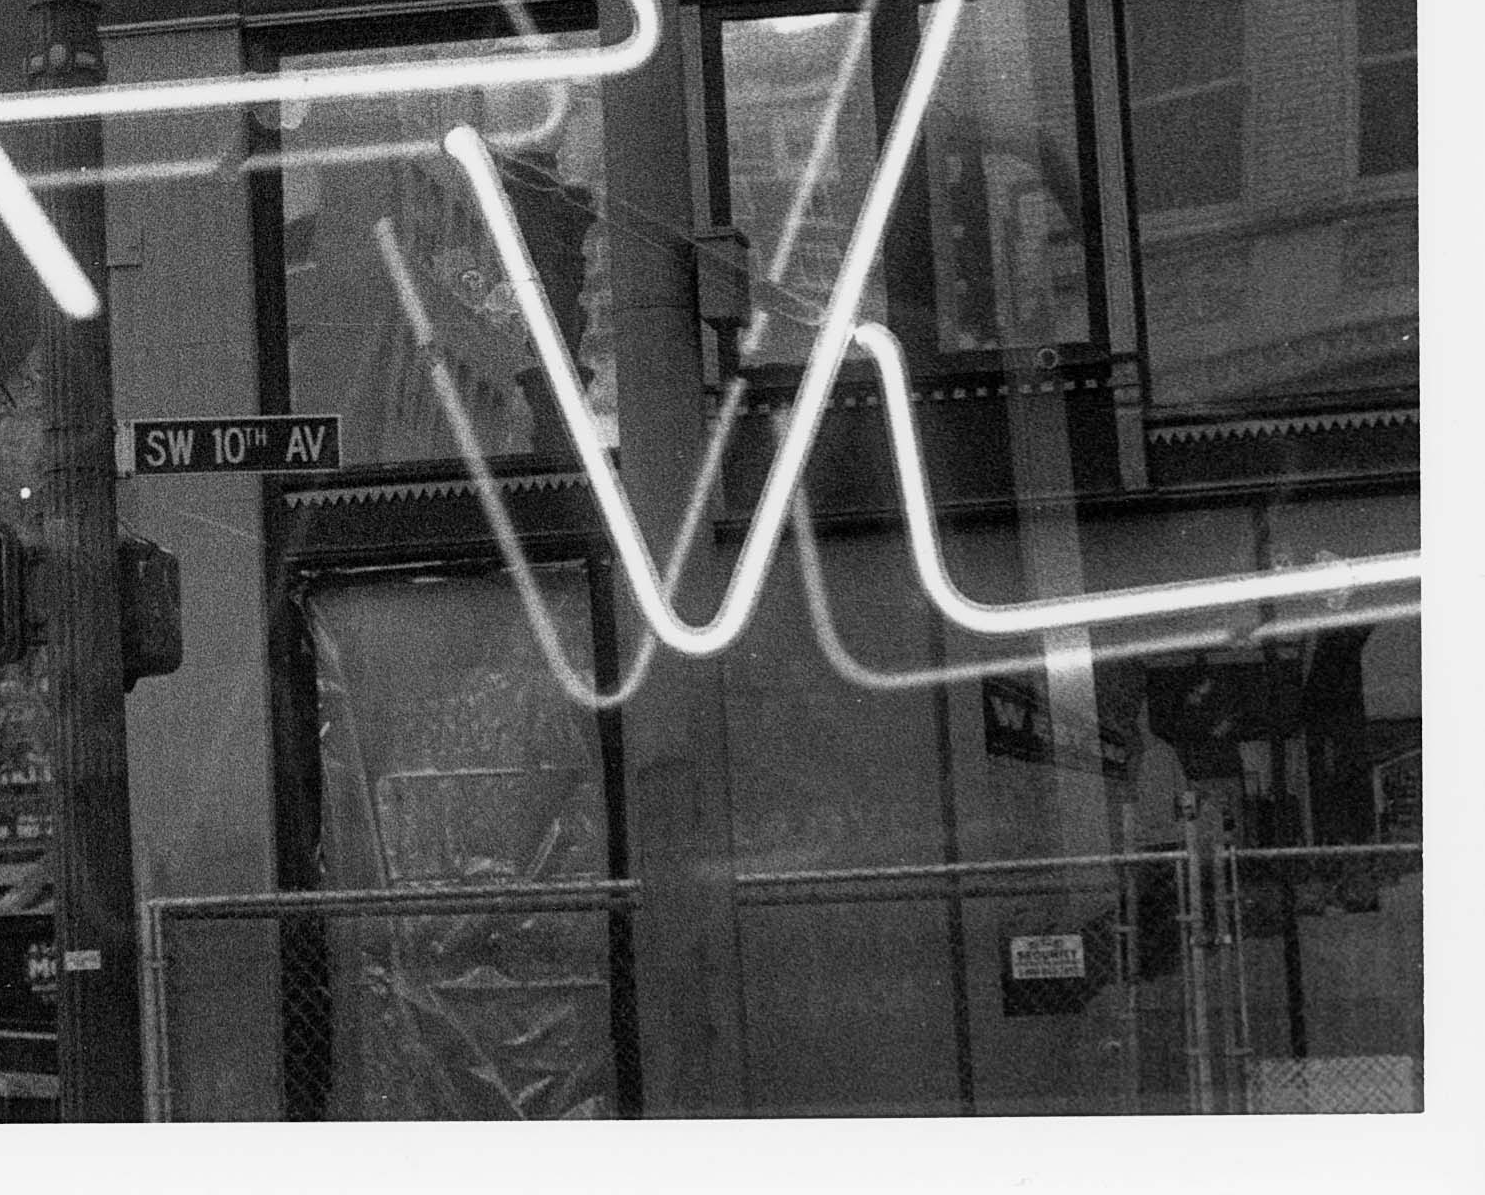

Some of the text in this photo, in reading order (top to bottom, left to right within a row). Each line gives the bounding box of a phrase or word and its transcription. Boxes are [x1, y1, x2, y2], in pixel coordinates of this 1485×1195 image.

[144, 424, 326, 467] SW 10TH AV
